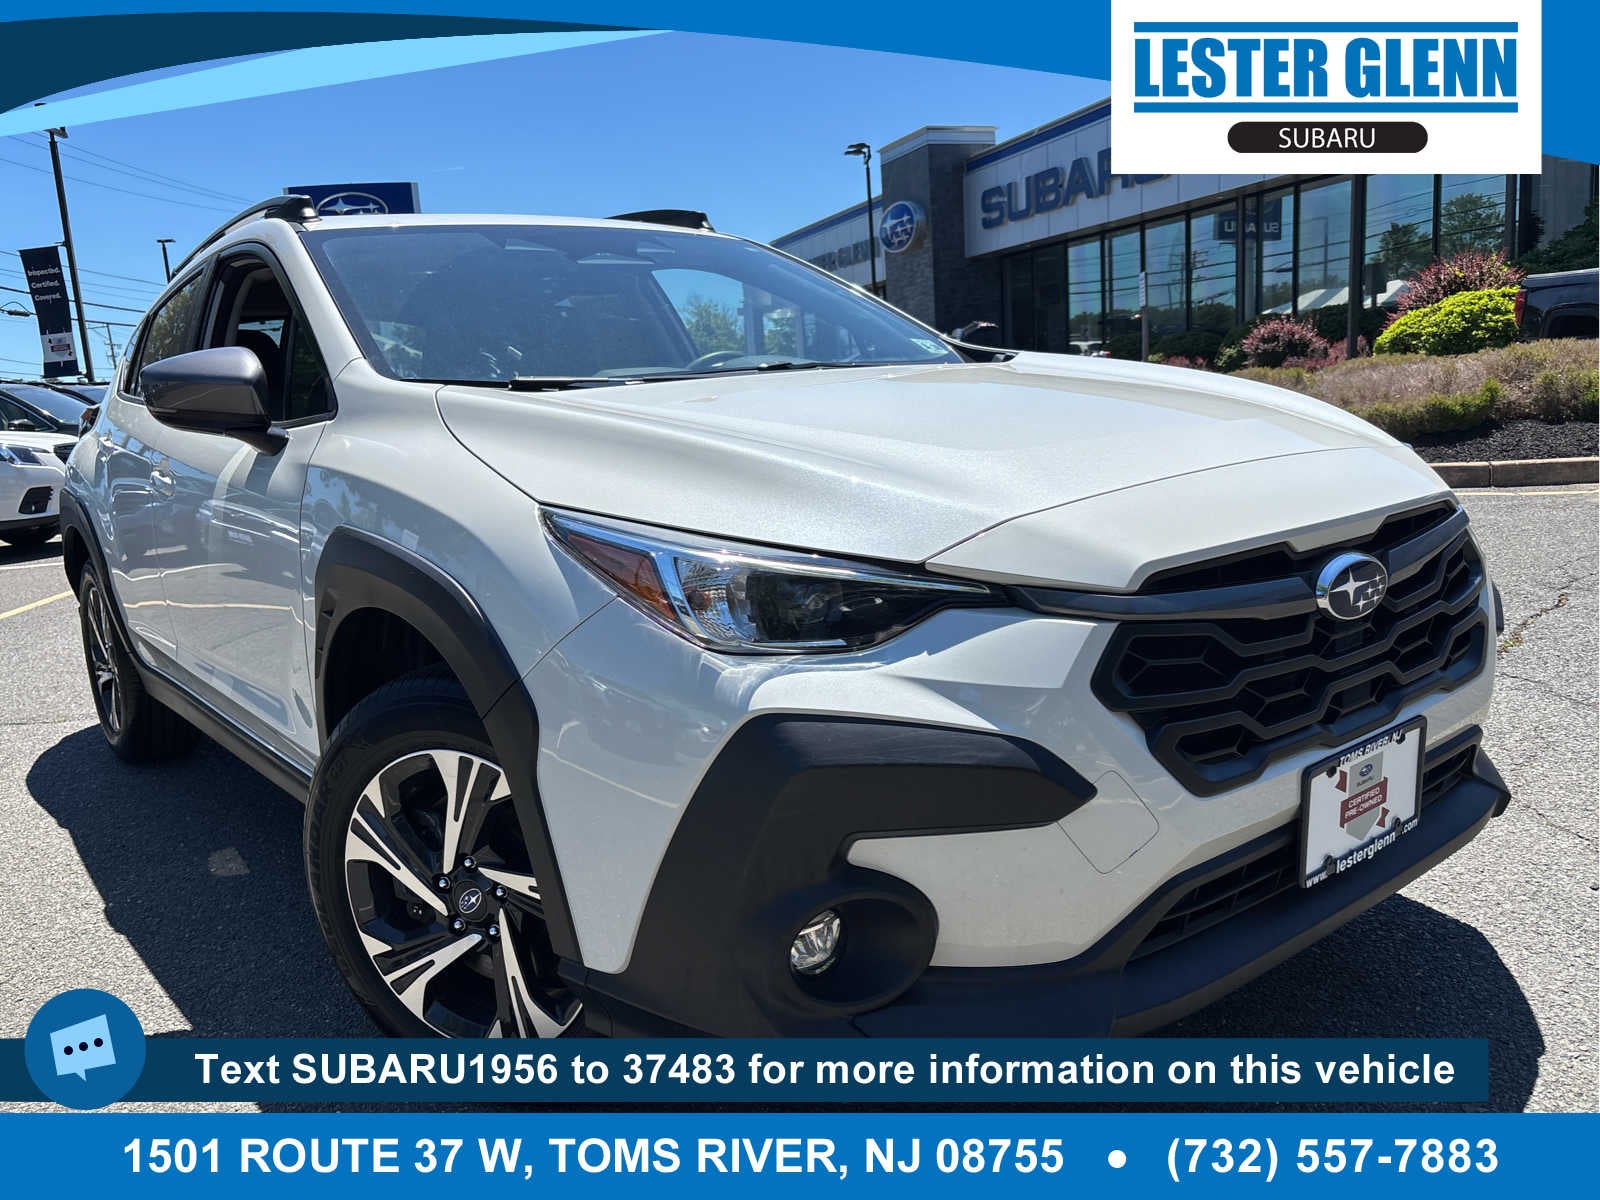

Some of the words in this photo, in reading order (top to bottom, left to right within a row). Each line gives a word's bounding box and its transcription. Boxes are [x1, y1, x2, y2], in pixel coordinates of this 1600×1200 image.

[981, 147, 1170, 230] SUBAR
[31, 280, 60, 289] Certified.
[34, 293, 62, 301] Covered.
[1340, 748, 1365, 766] TOMS
[1345, 794, 1383, 819] PRE-OWNED
[1348, 787, 1380, 808] CERTIFIED
